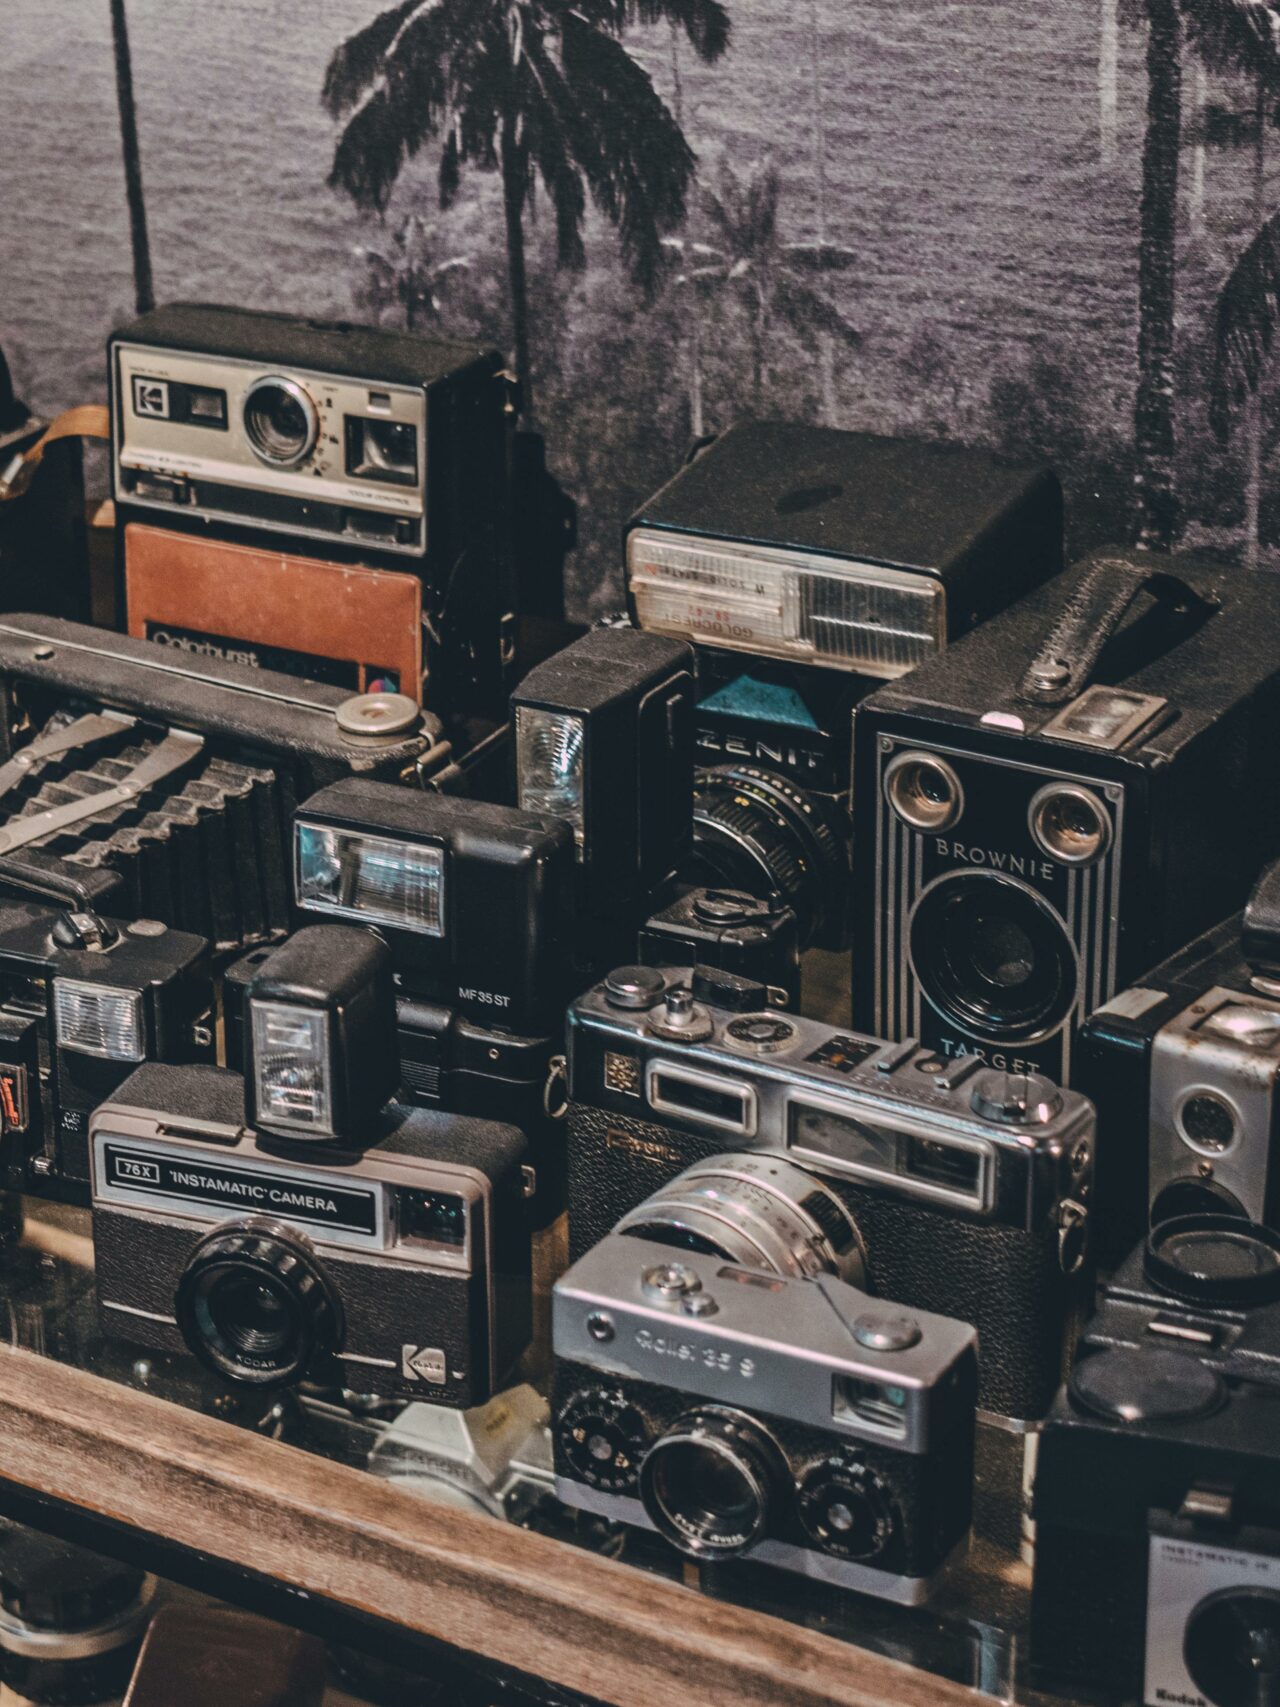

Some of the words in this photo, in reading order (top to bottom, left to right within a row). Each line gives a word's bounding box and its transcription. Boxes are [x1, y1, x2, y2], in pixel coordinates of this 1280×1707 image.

[696, 728, 824, 768] ZENIT
[935, 838, 1055, 881] BROWNIE
[940, 1038, 1040, 1075] TARGET
[270, 1190, 339, 1214] CAMERA
